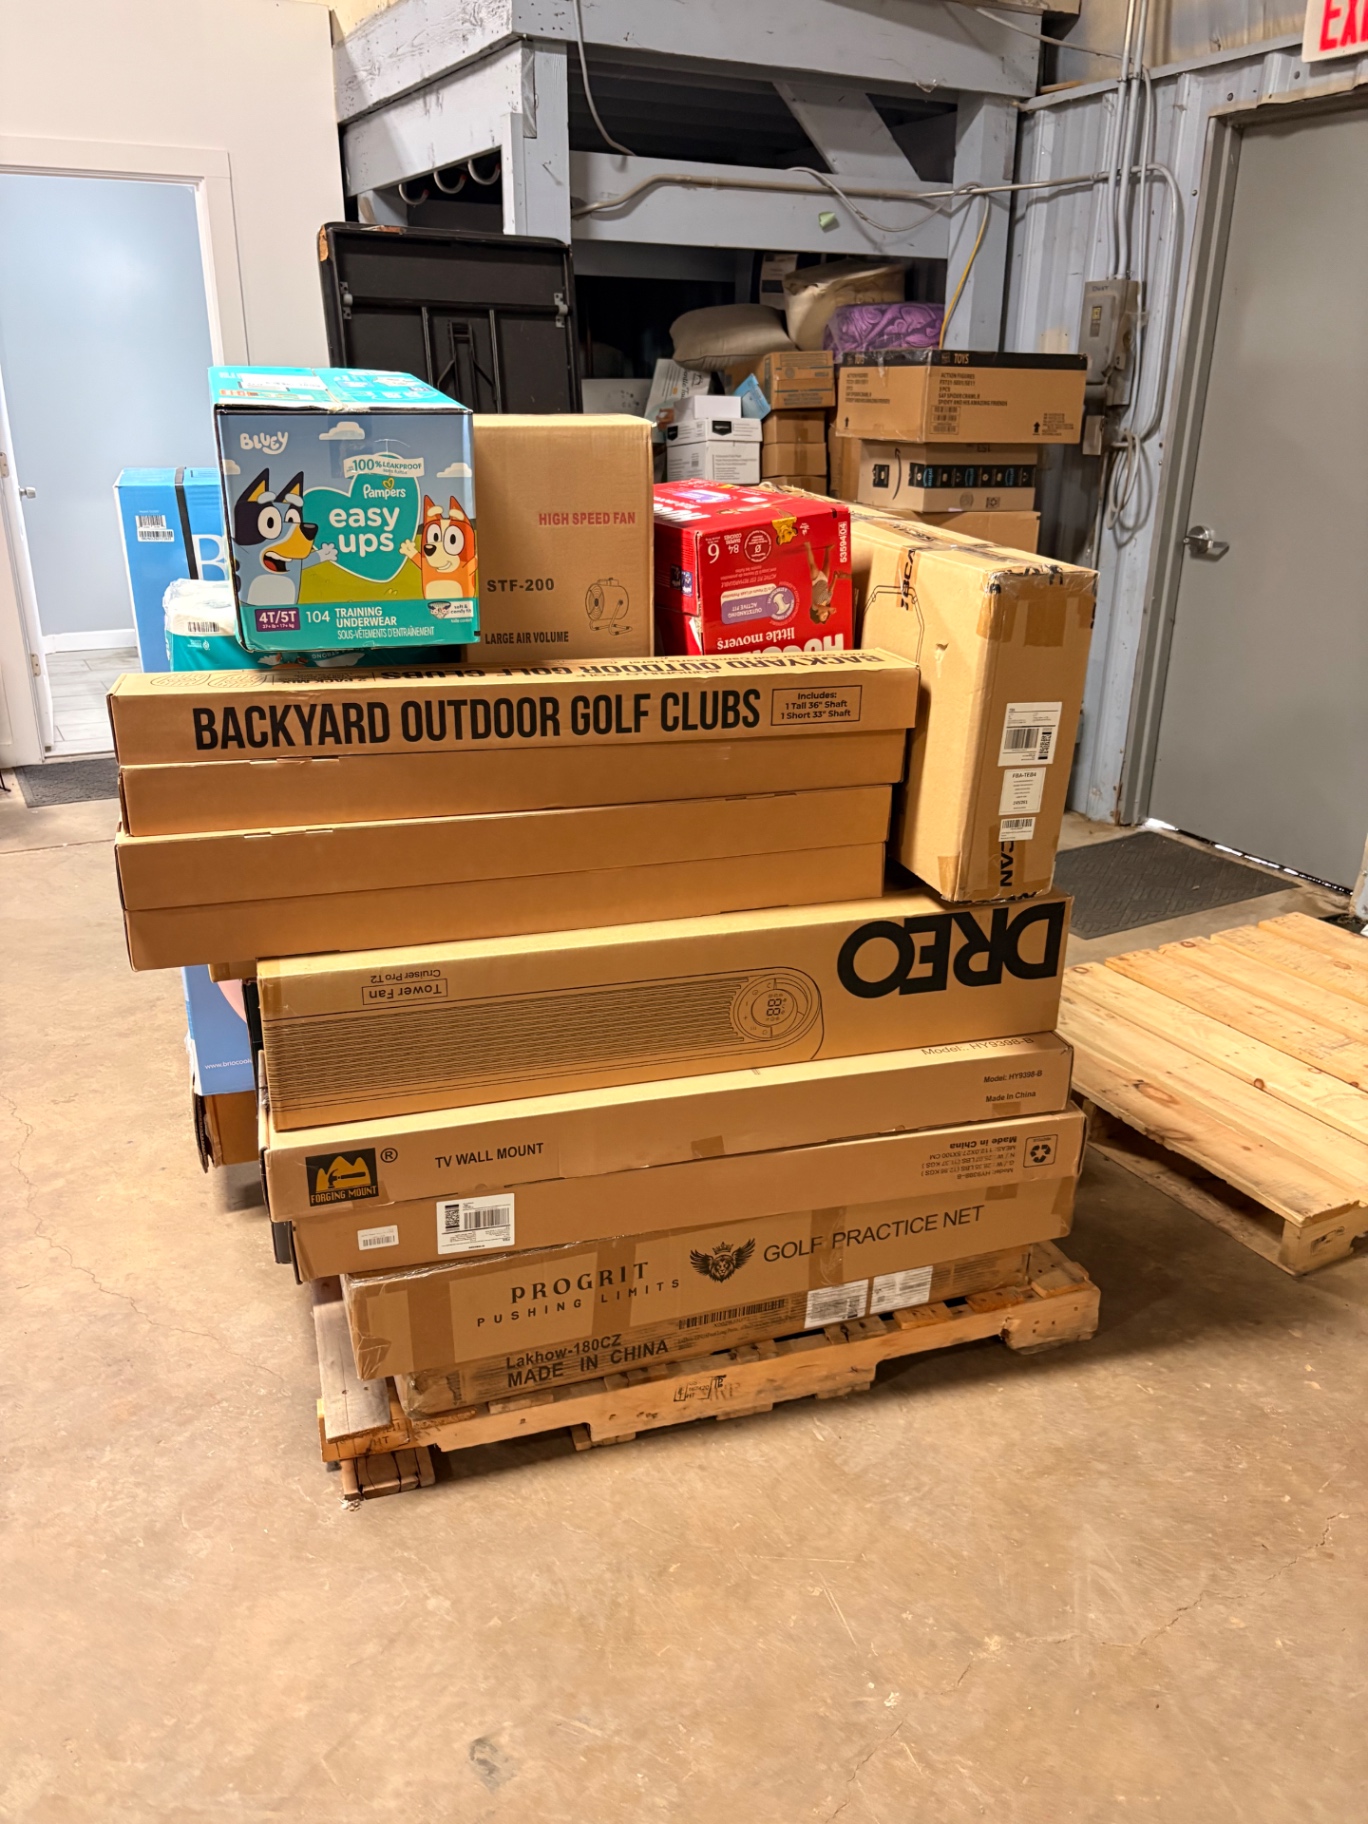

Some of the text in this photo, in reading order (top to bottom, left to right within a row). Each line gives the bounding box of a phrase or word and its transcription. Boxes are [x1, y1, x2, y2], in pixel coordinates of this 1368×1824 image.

[954, 353, 968, 364] TOYS
[240, 432, 289, 455] BLUEY
[352, 459, 382, 472] 100%
[382, 461, 422, 470] LEAKPROOF
[363, 484, 406, 500] Pampers
[329, 507, 400, 531] easy
[539, 512, 636, 526] HIGH SPEED FAN
[338, 532, 394, 558] ups
[728, 544, 739, 554] 84
[707, 543, 720, 564] 6
[487, 578, 555, 593] STF-200
[259, 610, 297, 624] 4T/5T
[305, 610, 331, 623] 104
[334, 606, 382, 618] TRAINING
[727, 608, 763, 619] OUTSTANDING
[336, 616, 397, 628] UNDERWEAR
[485, 631, 569, 645] LARGE AIR VOLUME
[766, 627, 795, 641] little
[717, 633, 764, 650] movers
[578, 662, 721, 674] OUTDOOR
[726, 655, 885, 669] BACKYARD
[381, 668, 486, 680] CLUBS
[497, 665, 573, 677] GOLF
[797, 691, 837, 700] Includes:
[791, 702, 806, 710] Tall
[808, 701, 822, 709] 36"
[824, 699, 847, 708] Shaft
[192, 688, 761, 750] BACKYARD OUTDOOR GOLF CLUBS
[786, 711, 810, 719] Short
[812, 710, 826, 718] 33"
[828, 709, 851, 717] Shaft
[837, 901, 1066, 999] DREO
[370, 969, 441, 984] Cruiser Pro T2
[369, 984, 442, 999] Tower Fan
[970, 1037, 1034, 1050] HY9398-B
[983, 1069, 1043, 1083] Model: HY9398-B
[986, 1094, 1005, 1103] Made
[1015, 1091, 1036, 1099] China
[949, 1140, 977, 1149] China
[435, 1142, 544, 1169] TV WALL MOUNT
[310, 1185, 378, 1203] FORGING MOUNT
[763, 1205, 985, 1262] GOLF PRACTICE NET
[511, 1261, 649, 1304] PROGRIT
[477, 1279, 680, 1327] PUSHING LIMITS
[506, 1333, 622, 1370] Lakhow-180CZ
[507, 1339, 669, 1388] MADE IN CHINA
